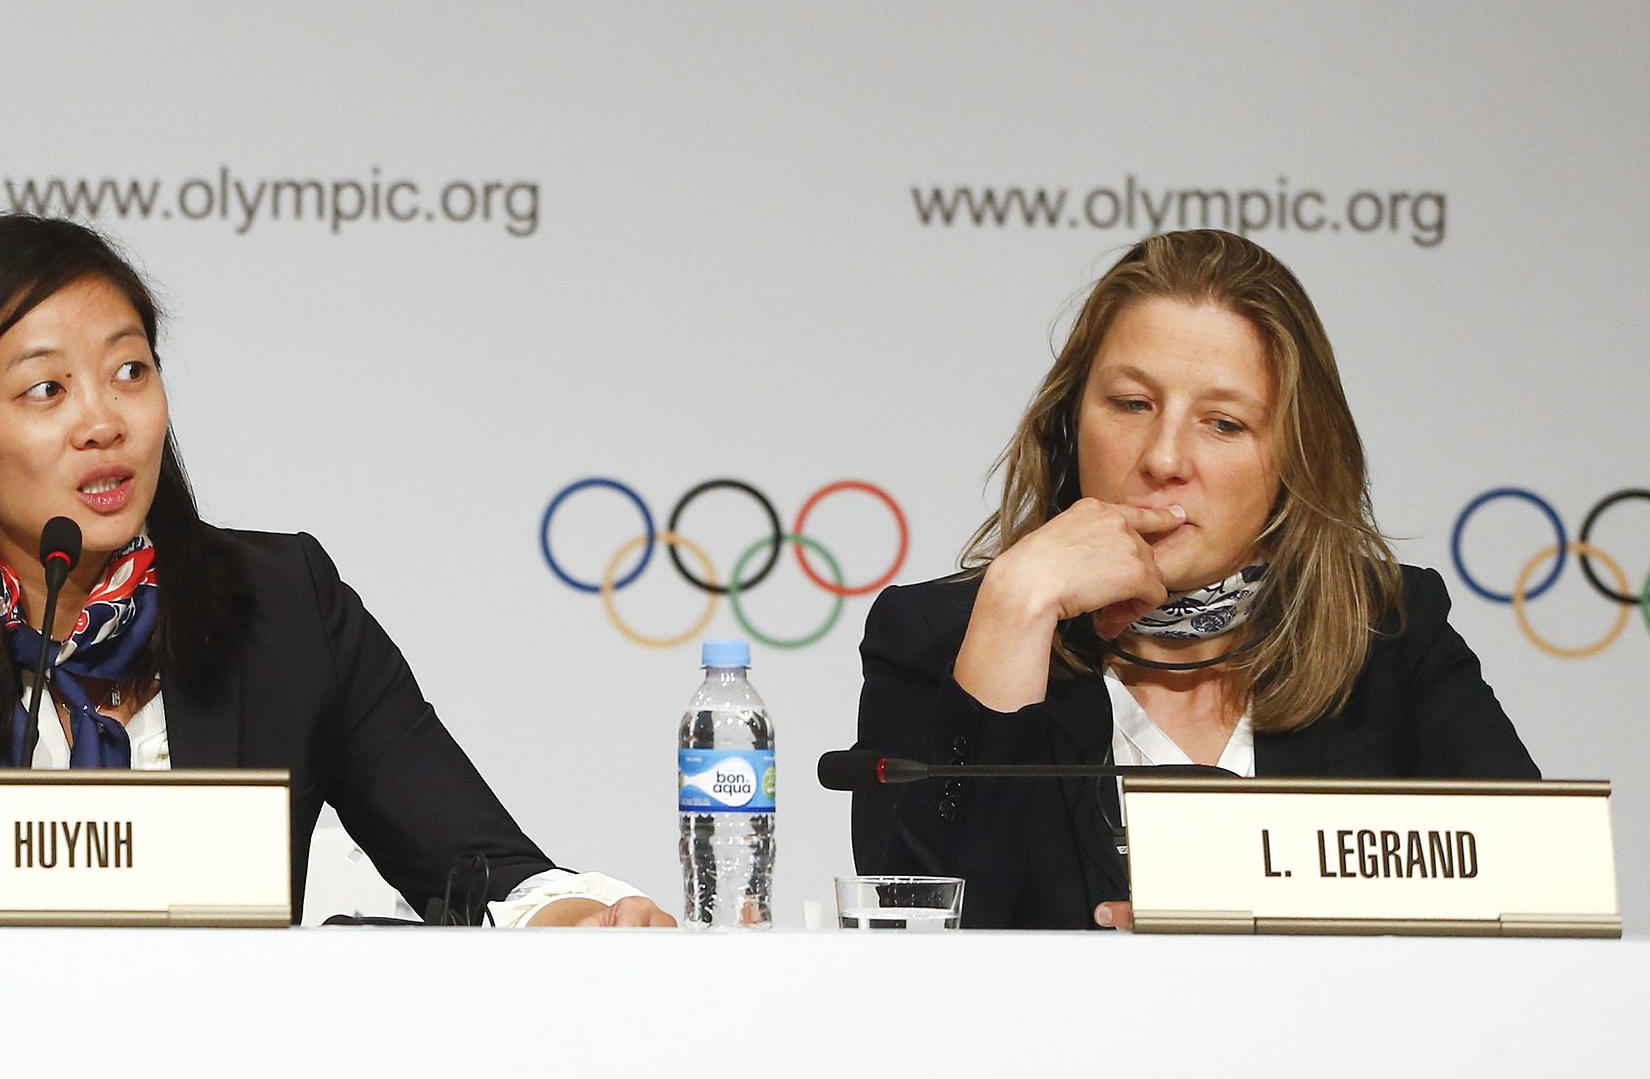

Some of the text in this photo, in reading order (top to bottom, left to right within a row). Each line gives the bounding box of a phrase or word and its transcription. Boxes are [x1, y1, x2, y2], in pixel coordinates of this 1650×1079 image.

[4, 166, 542, 238] www.olympic.org
[910, 174, 1449, 249] www.olympic.org
[712, 784, 751, 797] aqua
[14, 821, 134, 870] HUYNH
[1261, 829, 1479, 880] L. LEGRAND
